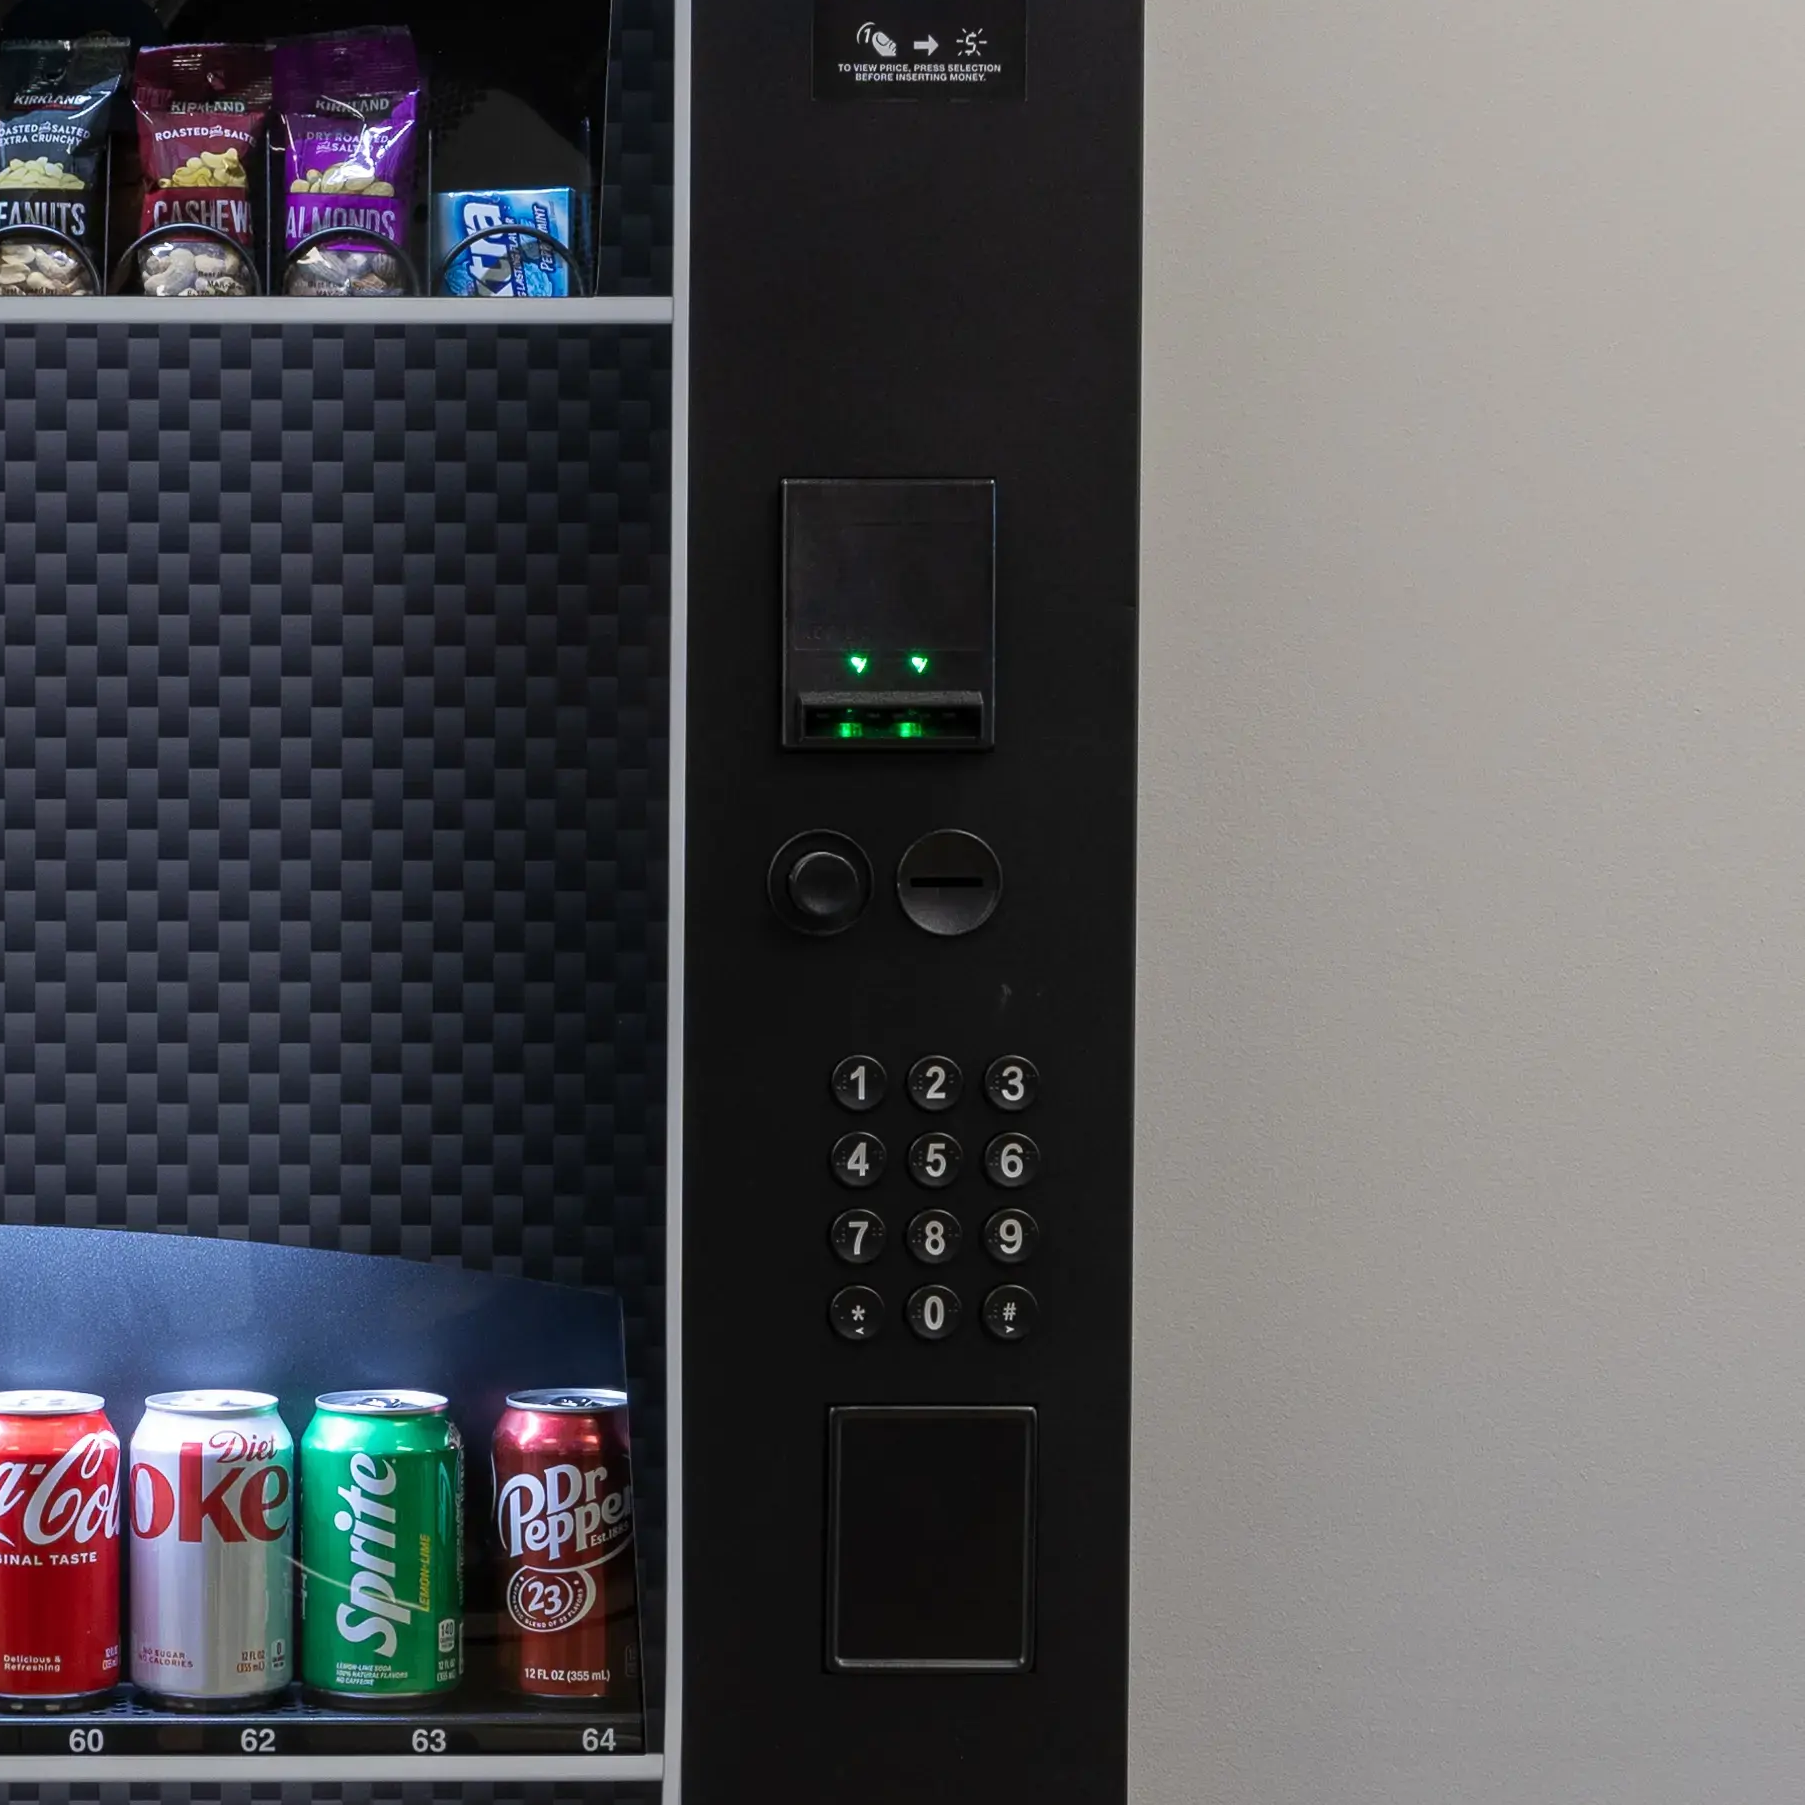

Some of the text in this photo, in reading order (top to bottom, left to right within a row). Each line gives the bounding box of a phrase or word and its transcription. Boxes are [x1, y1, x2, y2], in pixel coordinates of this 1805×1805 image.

[838, 63, 1001, 73] TO VIEW PRICE, PRESS SELECTION
[855, 73, 987, 81] BEFORE INSERTING MONEY.
[13, 92, 87, 105] KIRKLAND
[31, 134, 82, 146] CRUNCHY
[155, 127, 209, 142] ROASTED
[306, 132, 332, 141] DRY
[285, 206, 397, 241] ALMONDS
[849, 1065, 1025, 1101] 1 2 3
[847, 1142, 1024, 1178] 4 5 6
[848, 1218, 1023, 1256] 7 8 9
[923, 1295, 945, 1330] 0
[208, 1429, 278, 1464] Diet
[543, 1463, 608, 1516] Dr
[49, 1551, 98, 1566] TASTE
[334, 1452, 412, 1658] Sprite
[418, 1533, 431, 1613] LEMON-LIME
[527, 1580, 563, 1616] 23
[3, 1654, 51, 1663] Delicious
[148, 1655, 194, 1668] CALORIES
[154, 1649, 186, 1660] SUGAR
[3, 1663, 61, 1673] Refreshing
[524, 1667, 536, 1679] 12
[537, 1668, 549, 1680] FL
[550, 1669, 565, 1681] OZ
[566, 1669, 590, 1684] (355
[68, 1730, 104, 1754] 60
[240, 1729, 276, 1752] 62
[411, 1729, 447, 1753] 63
[582, 1728, 616, 1752] 64
